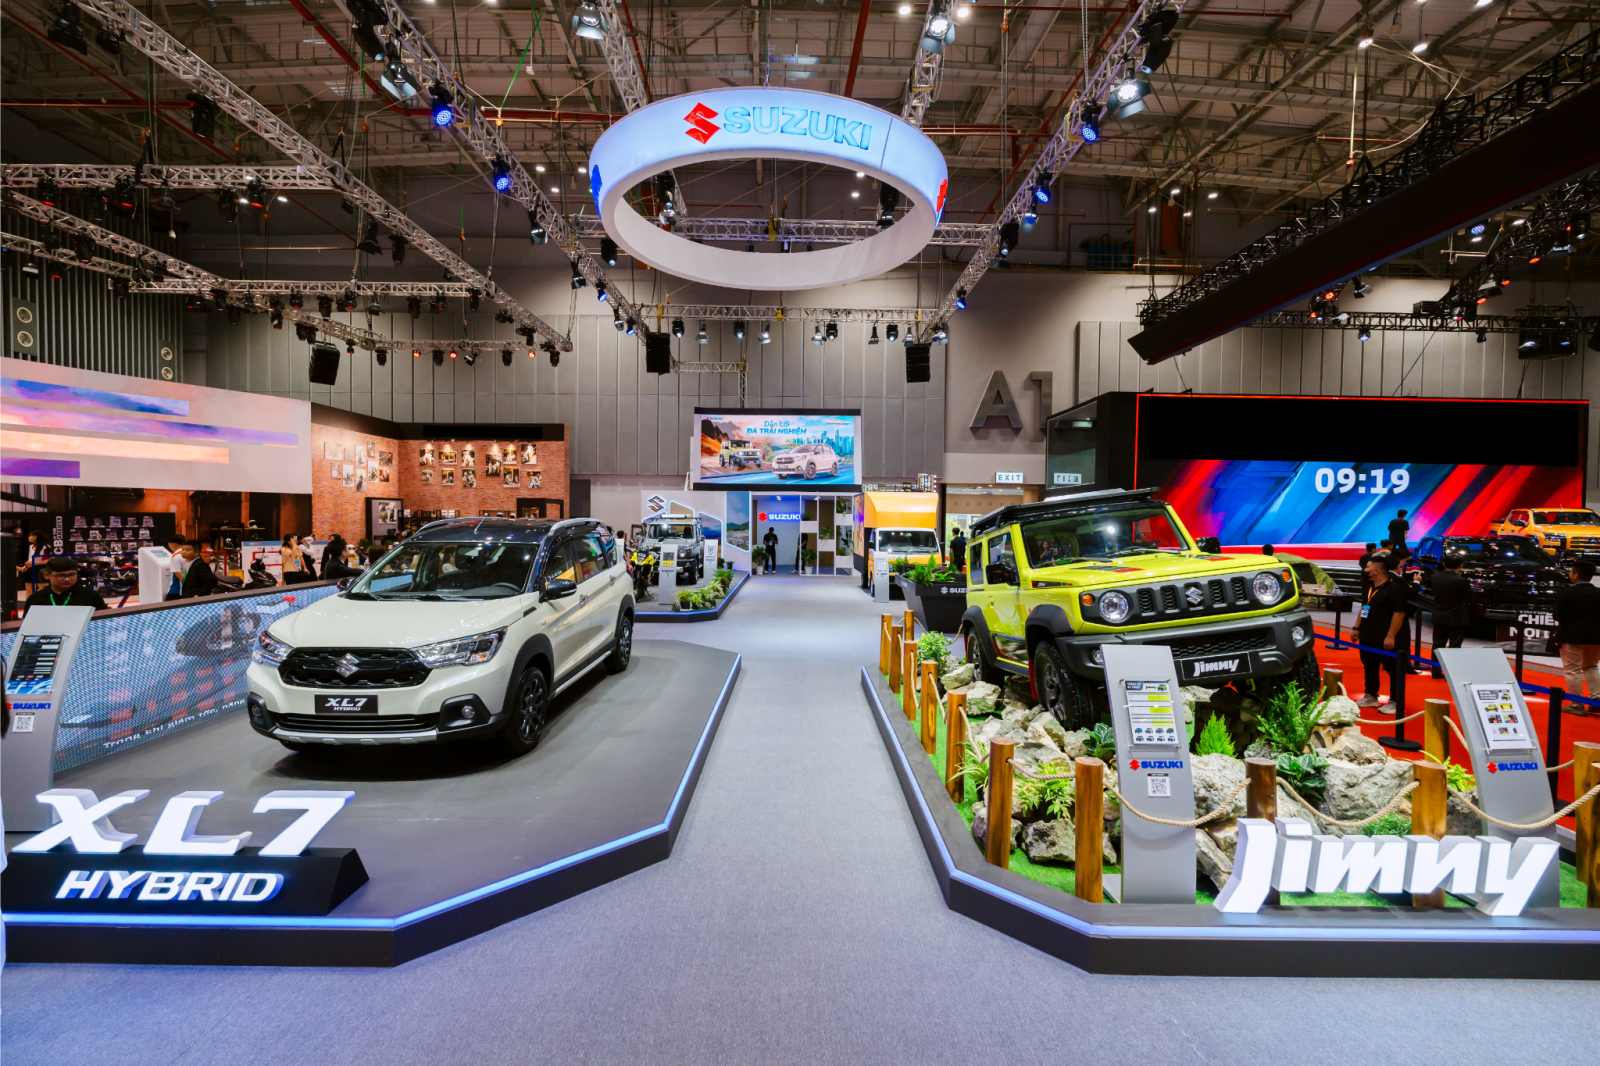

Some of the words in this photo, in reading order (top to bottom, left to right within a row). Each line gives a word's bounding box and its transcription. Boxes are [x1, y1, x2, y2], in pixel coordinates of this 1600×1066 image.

[723, 106, 873, 151] SUZUKI
[968, 370, 1053, 443] A1
[997, 474, 1021, 482] EXIT
[1314, 467, 1411, 495] 09:19
[13, 702, 52, 710] SUZUKI
[324, 697, 368, 707] XL7
[1140, 760, 1184, 769] SUZUKI
[1498, 762, 1539, 771] SUZUKI
[11, 788, 357, 857] XL7
[1212, 816, 1561, 917] Jimny
[55, 869, 286, 903] HYBRID
